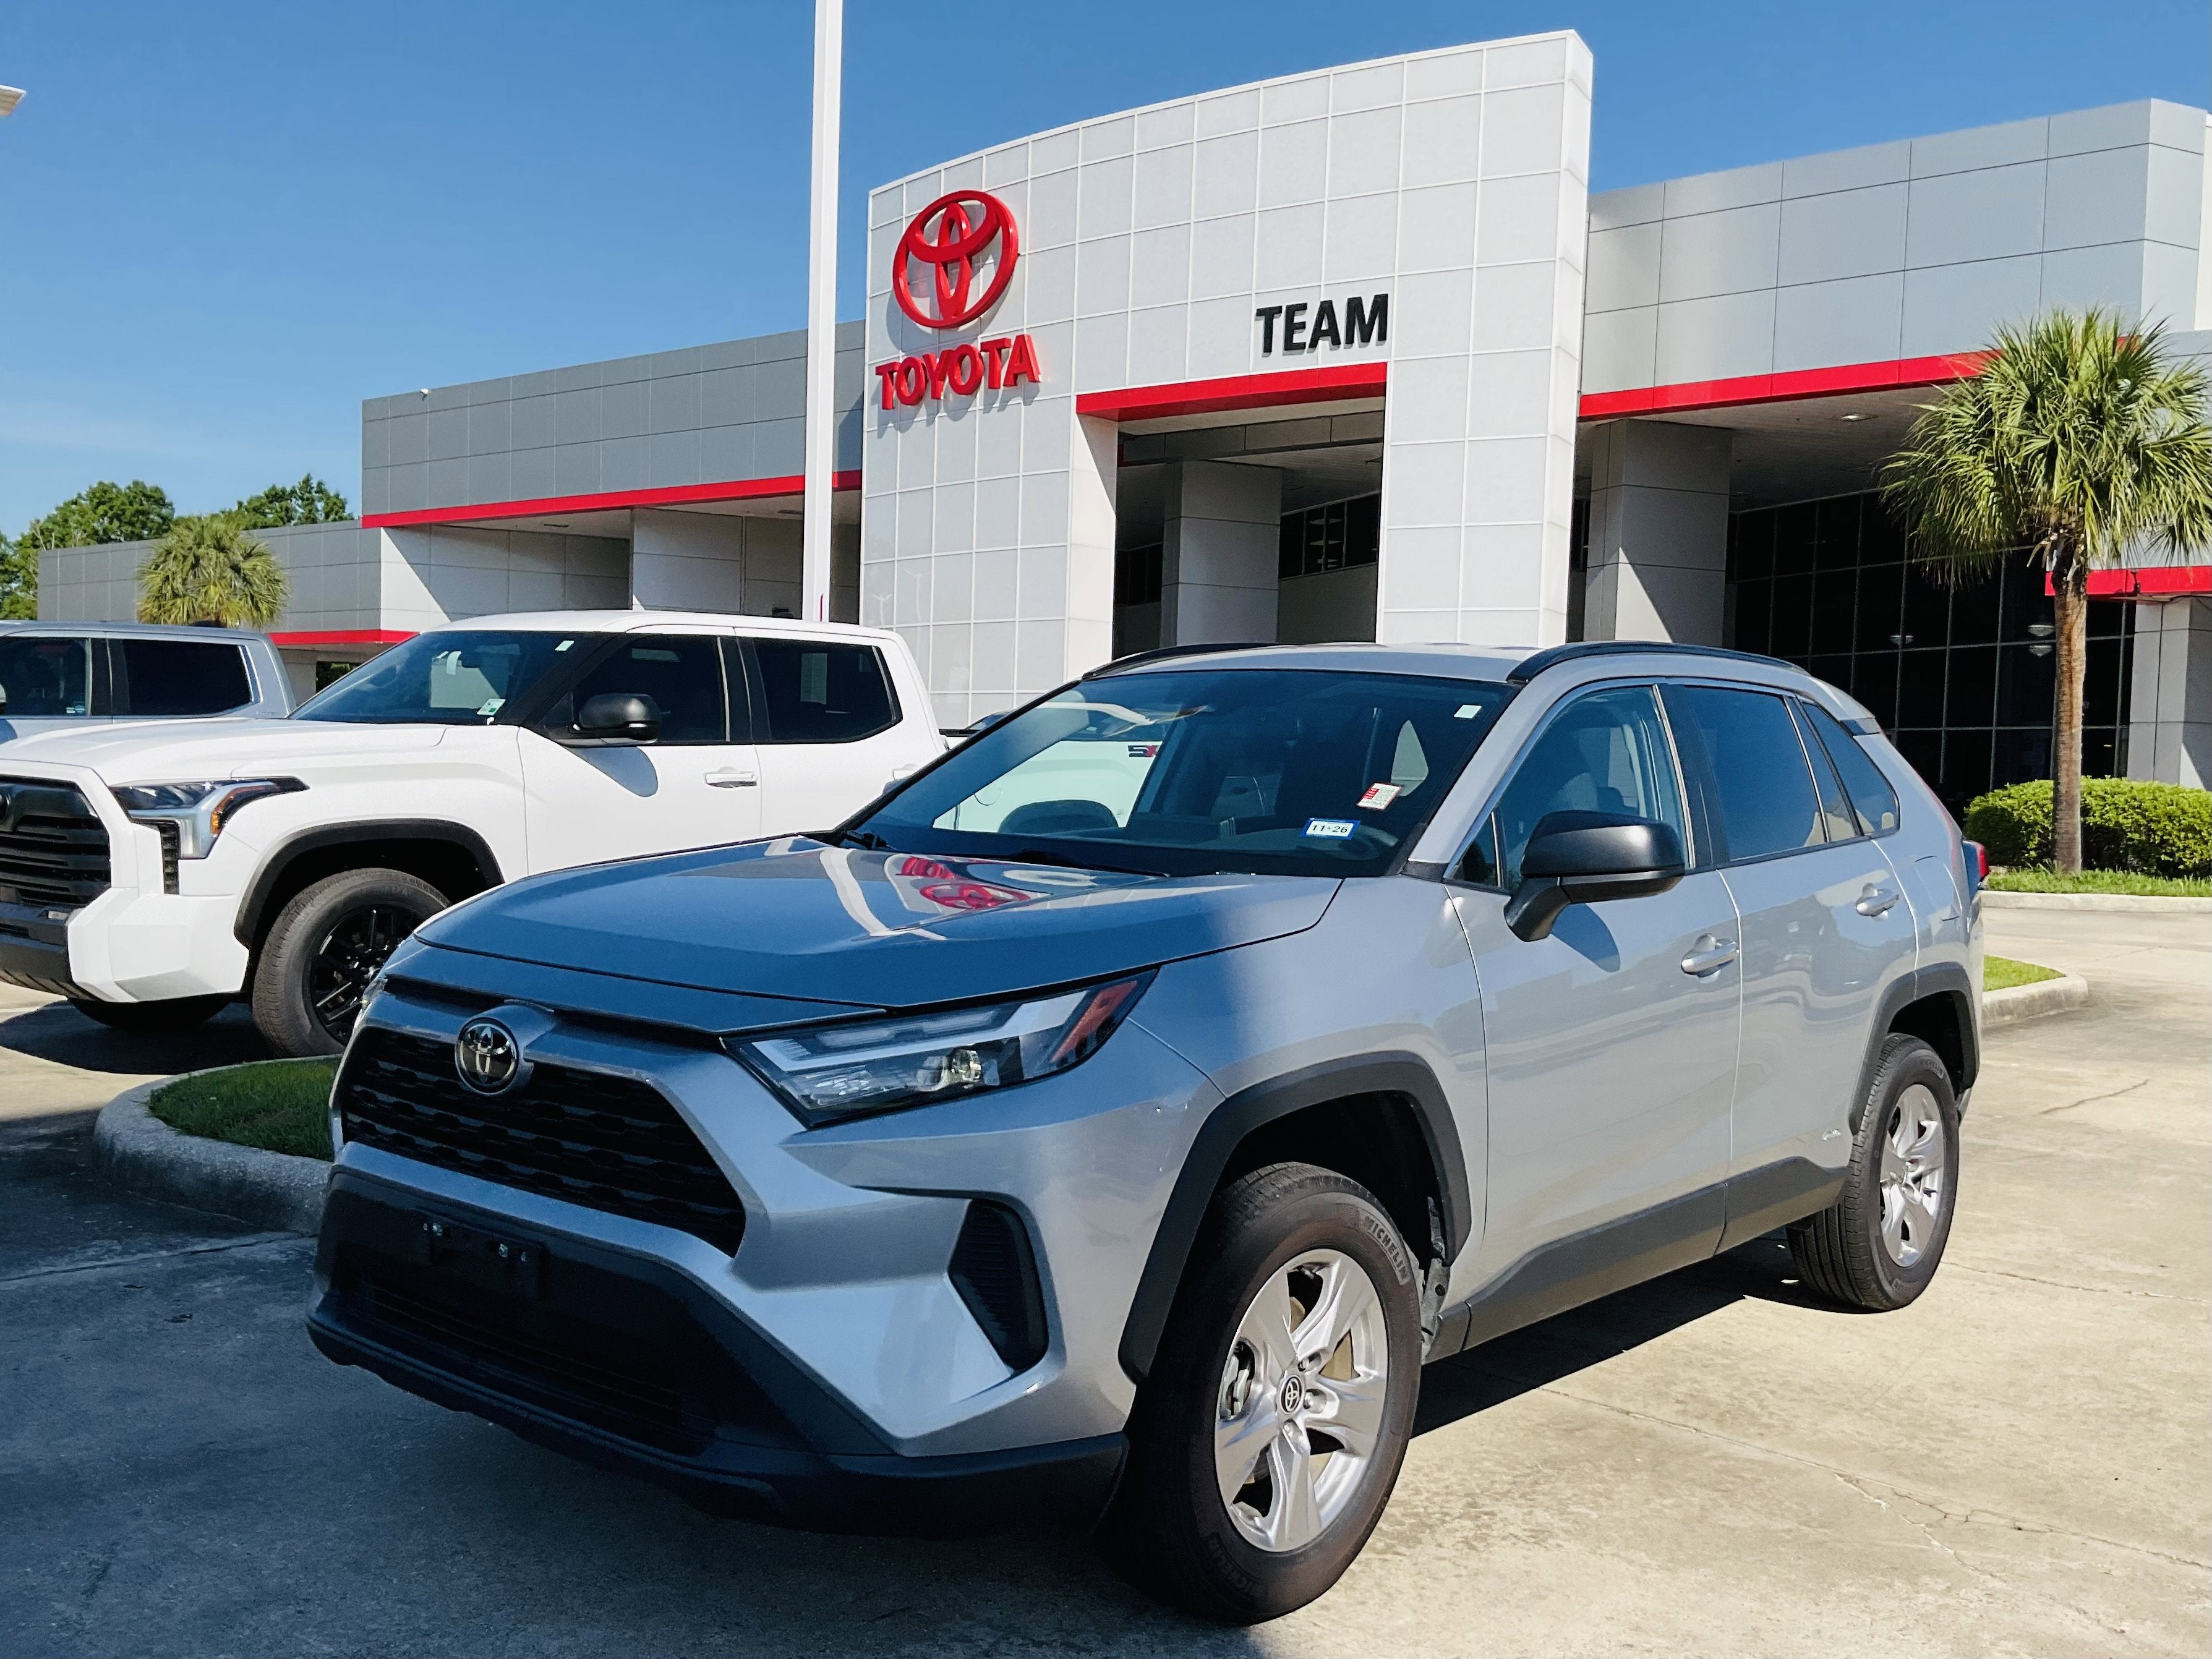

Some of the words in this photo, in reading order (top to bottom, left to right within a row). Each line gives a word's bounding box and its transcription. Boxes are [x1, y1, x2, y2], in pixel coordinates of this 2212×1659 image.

[1256, 294, 1388, 353] TEAM
[876, 334, 1040, 409] TOYOTA
[1364, 1216, 1408, 1281] MICHELIN
